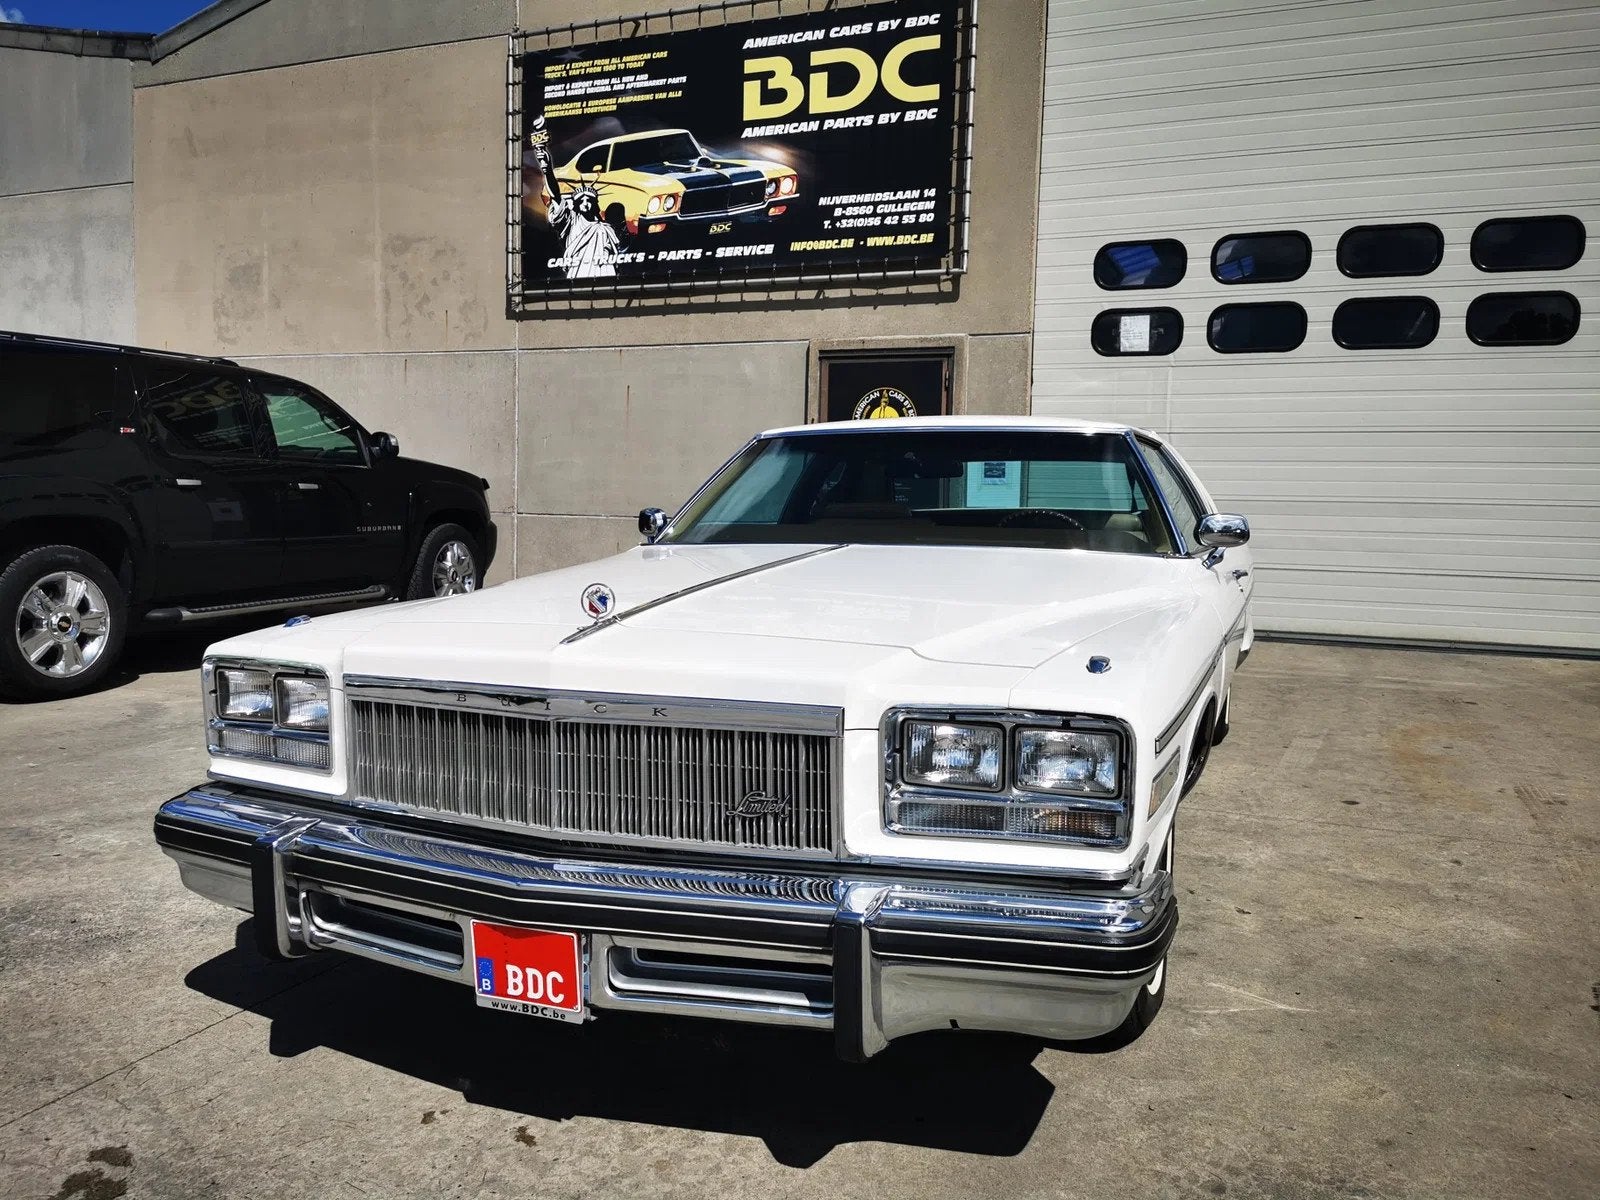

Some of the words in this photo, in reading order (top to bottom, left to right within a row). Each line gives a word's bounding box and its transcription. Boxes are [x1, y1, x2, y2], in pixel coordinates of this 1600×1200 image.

[742, 29, 825, 50] AMERICAN
[829, 22, 873, 38] CARS
[876, 19, 902, 32] BY
[904, 13, 941, 28] BDC
[544, 64, 566, 73] IMPORT
[571, 60, 593, 69] EXPORT
[593, 58, 610, 66] FROM
[622, 53, 652, 62] AMERICAN
[652, 51, 668, 59] CARS
[586, 66, 602, 74] FROM
[626, 60, 645, 69] TODAY
[544, 84, 566, 92] IMPORT
[571, 80, 593, 89] EXPORT
[593, 78, 610, 86] FROM
[622, 75, 636, 83] NEW
[636, 73, 649, 81] AND
[743, 34, 941, 121] BDC
[544, 90, 566, 99] SECOND
[586, 85, 611, 94] ORIGINAL
[612, 83, 625, 91] AND
[626, 78, 667, 89] AFTERMARKET
[667, 76, 687, 84] PARTS
[668, 90, 683, 98] ALLE
[741, 120, 820, 139] AMERICAN
[823, 114, 874, 131] PARTS
[877, 111, 902, 125] BY
[904, 107, 938, 122] BDC
[531, 131, 549, 143] BDC
[818, 189, 921, 206] NIJVERHEIDSLAAN
[923, 188, 936, 198] 14
[833, 205, 874, 217] B-8560
[876, 200, 936, 214] GULLEGEM
[709, 222, 732, 234] BDC
[823, 220, 832, 229] T.
[835, 216, 881, 230] +32(0)56
[883, 215, 899, 225] 42
[901, 214, 916, 224] 55
[918, 213, 935, 223] 80
[790, 238, 854, 252] INFO@BDC.BE
[866, 233, 935, 247] WWW.BDC.BE
[547, 257, 580, 268] CARS
[593, 252, 645, 266] TRUCK'S
[657, 248, 703, 261] PARTS
[715, 244, 775, 258] SERVICE
[854, 390, 880, 420] MERICAN
[888, 390, 905, 403] CARS
[903, 400, 912, 409] BY
[455, 692, 669, 718] BUICK
[726, 790, 790, 818] Limited
[481, 978, 491, 991] B
[506, 964, 565, 1004] BDC
[491, 1001, 566, 1020] www.BDC.be
